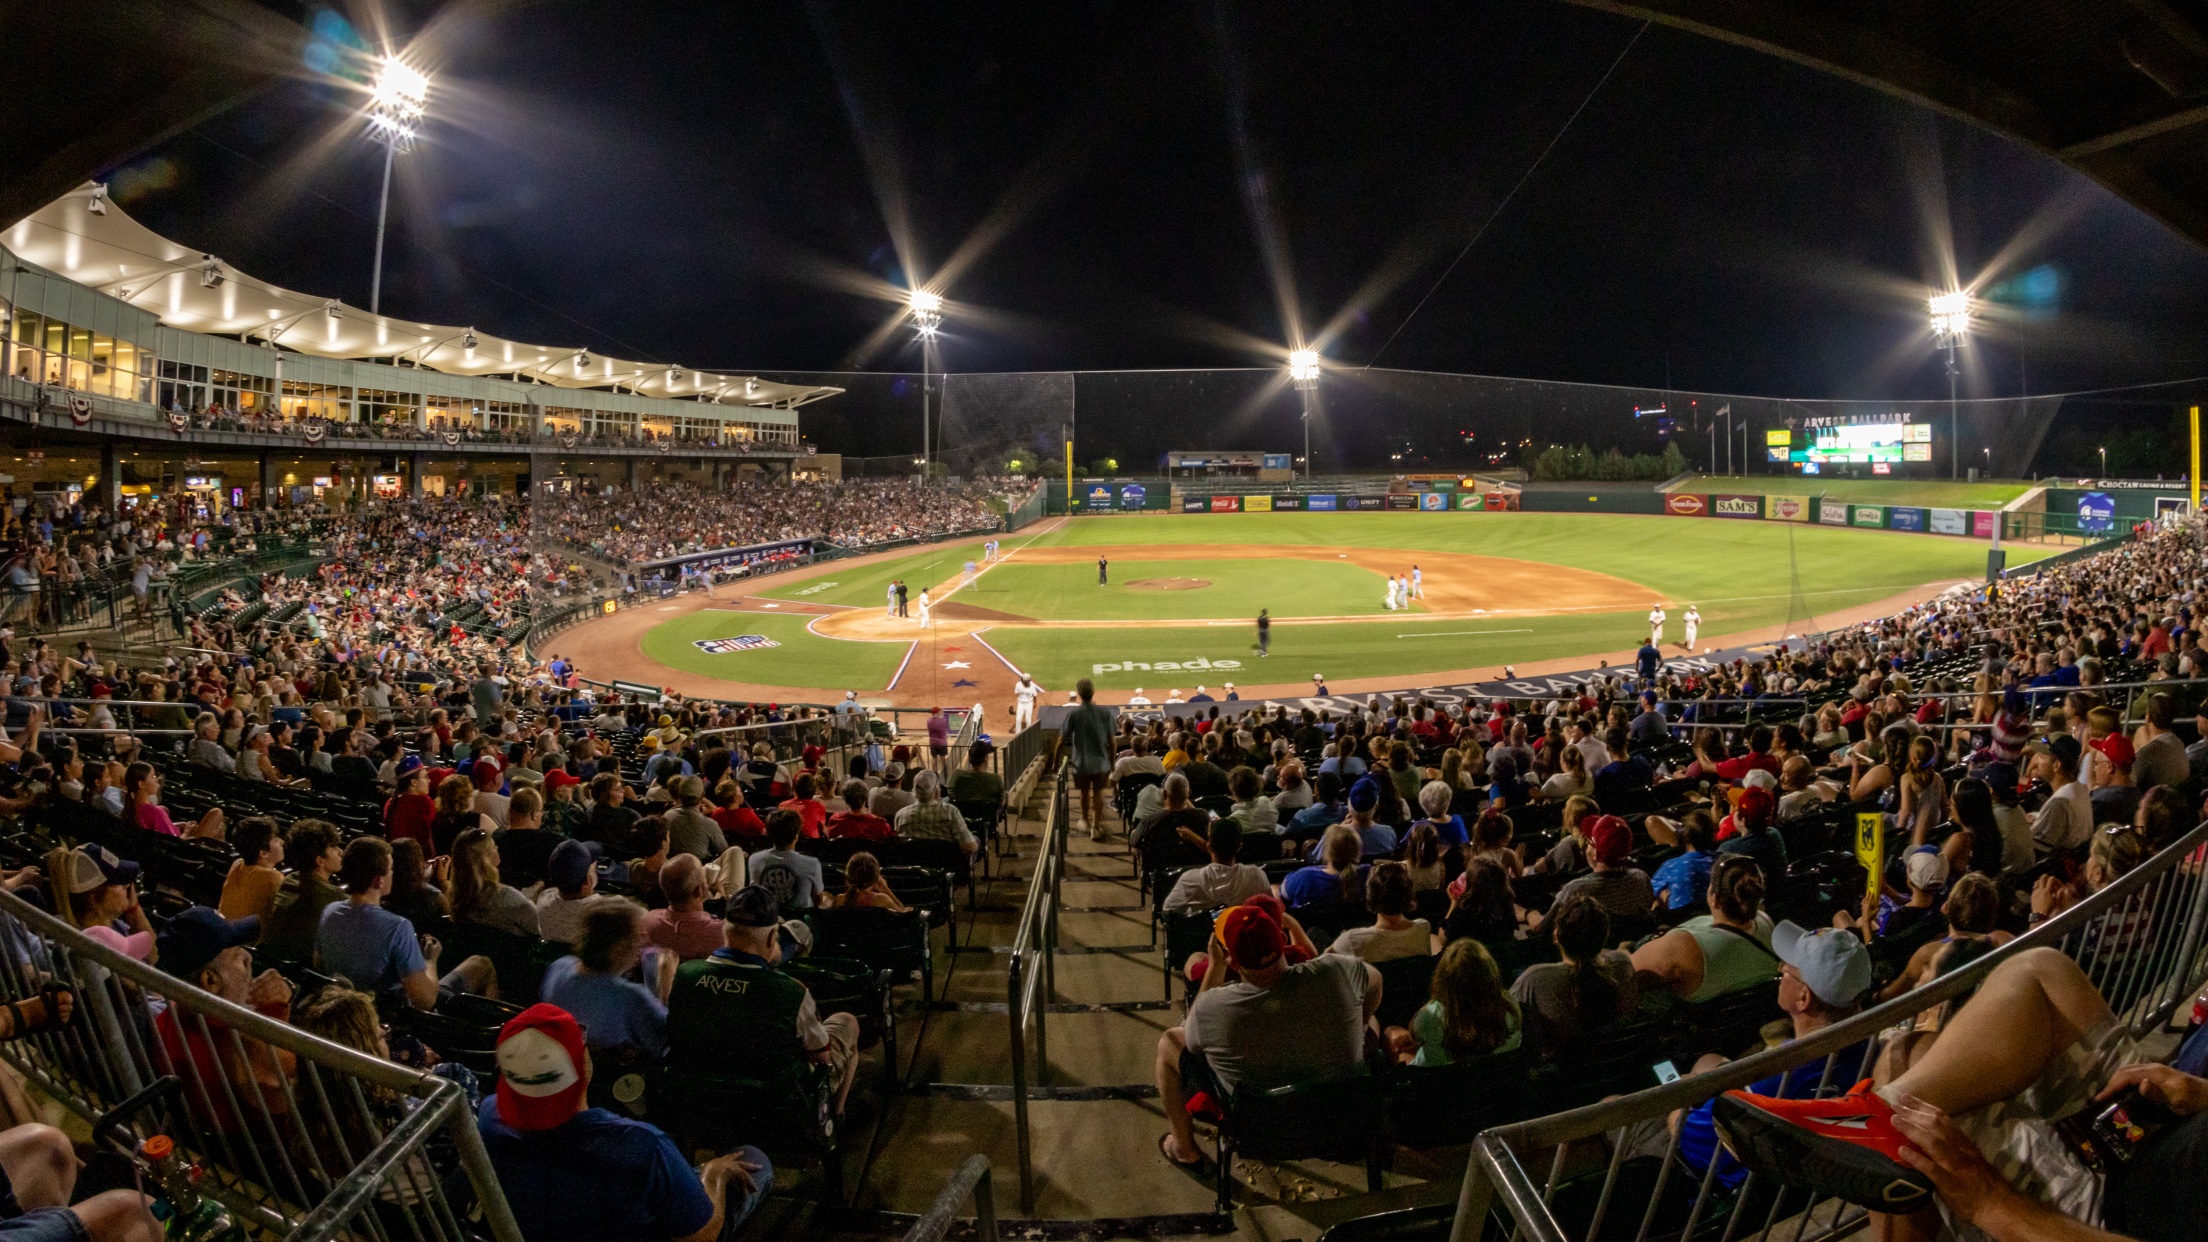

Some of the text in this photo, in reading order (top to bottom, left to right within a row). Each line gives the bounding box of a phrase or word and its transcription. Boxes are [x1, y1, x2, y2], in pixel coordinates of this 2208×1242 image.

[1804, 412, 1911, 427] ARVEST BALLPARK
[2102, 480, 2139, 489] CHOCTAW
[1669, 500, 1703, 508] Tyson Foods
[1718, 501, 1756, 512] SAM'S
[1092, 656, 1242, 676] phade
[695, 974, 751, 995] ARVEST
